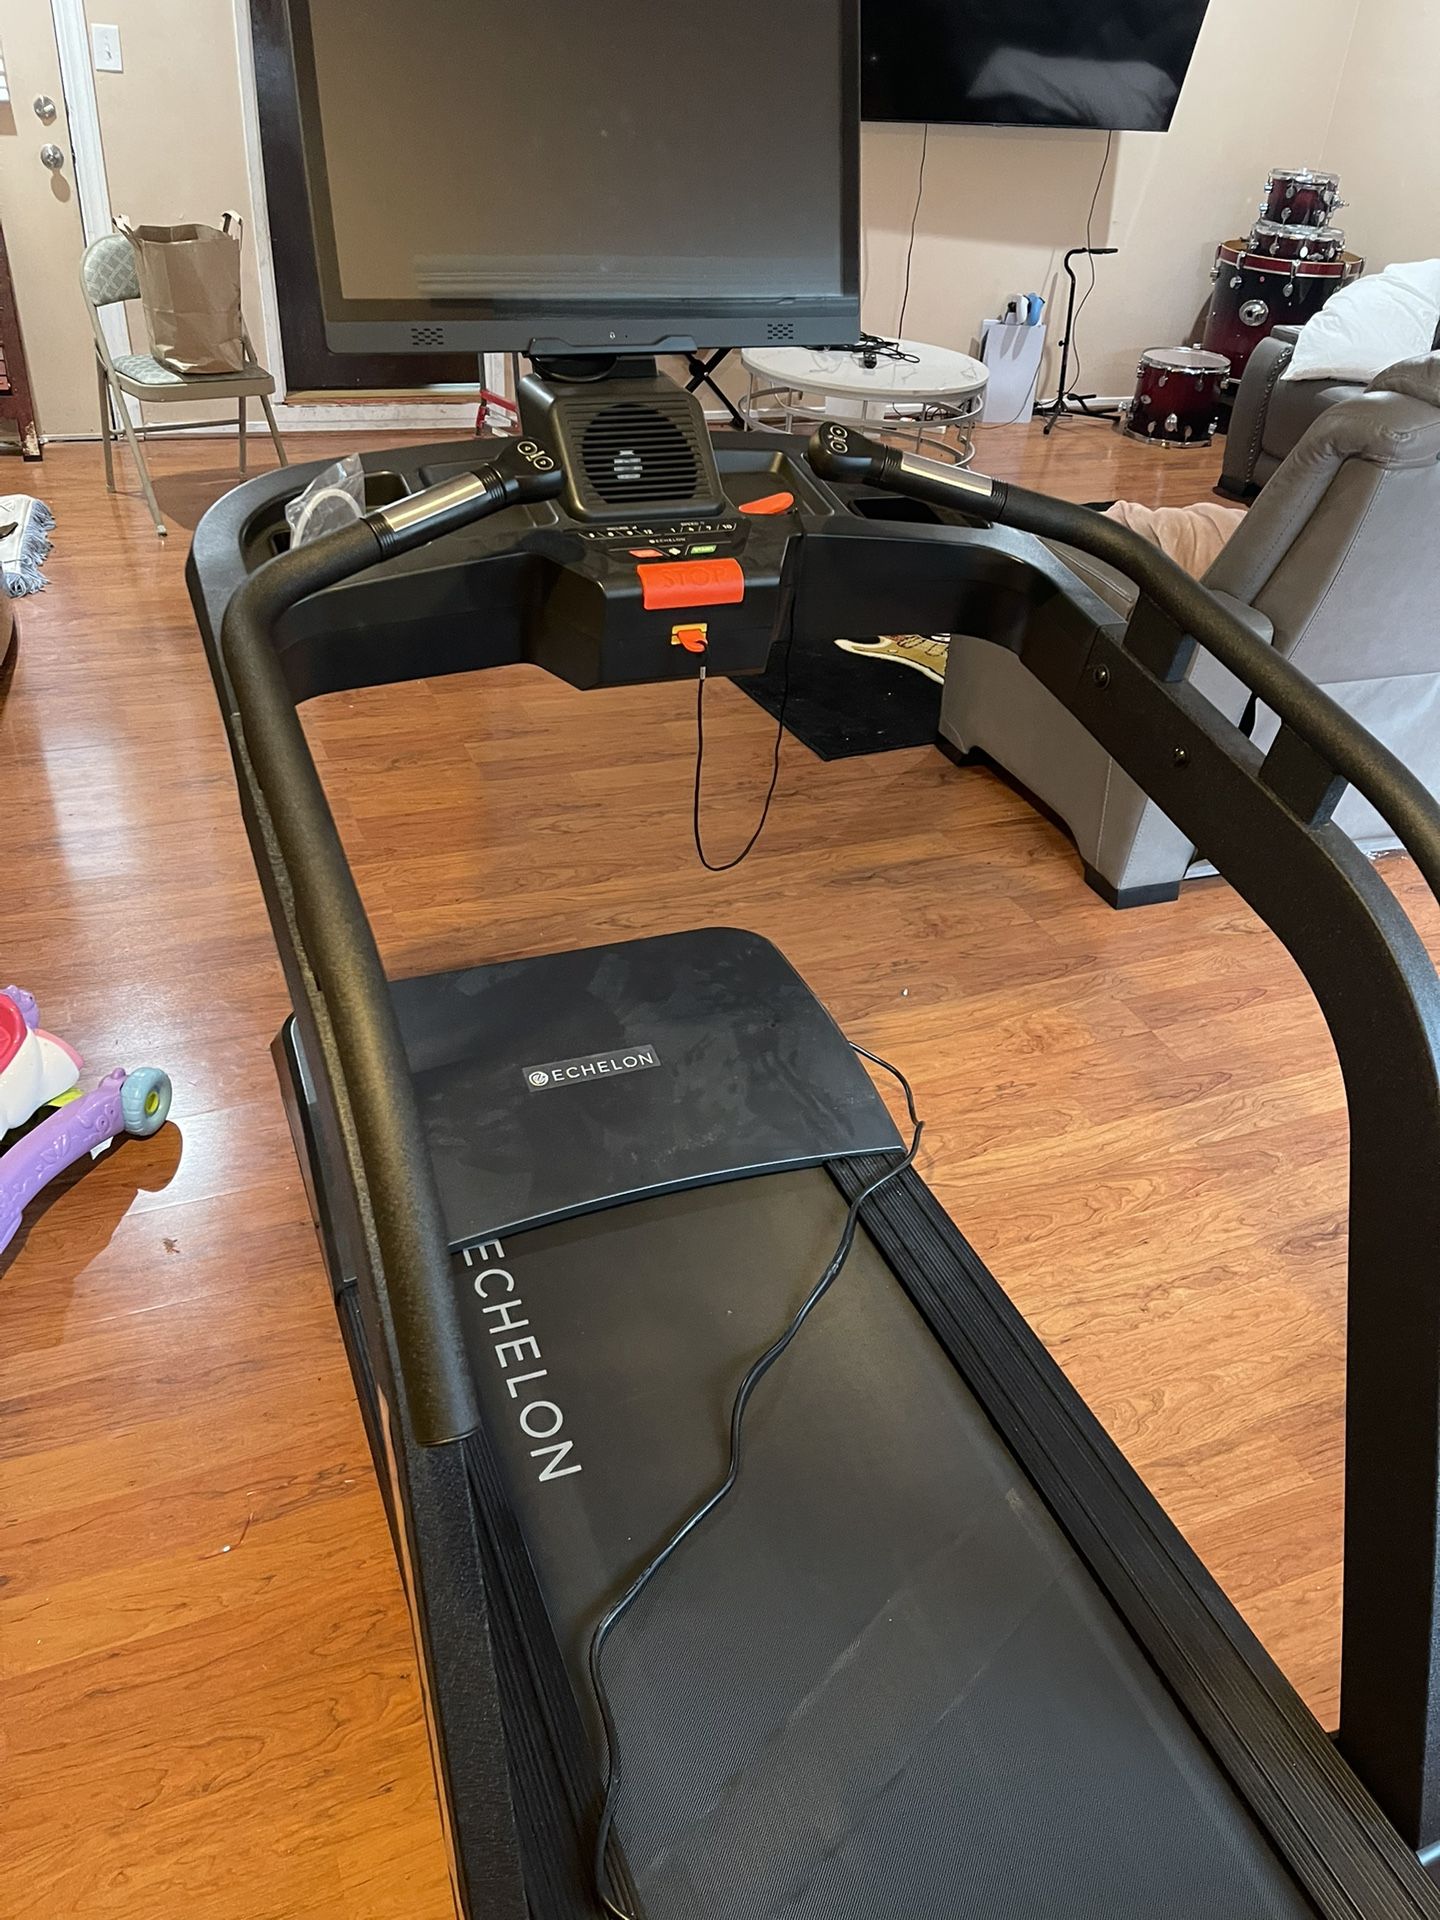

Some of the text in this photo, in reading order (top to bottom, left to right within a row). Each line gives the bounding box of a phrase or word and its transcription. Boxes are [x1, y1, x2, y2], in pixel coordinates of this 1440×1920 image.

[661, 566, 727, 589] STOP
[551, 1051, 654, 1082] ECHELON
[462, 1238, 582, 1482] ECHELON
